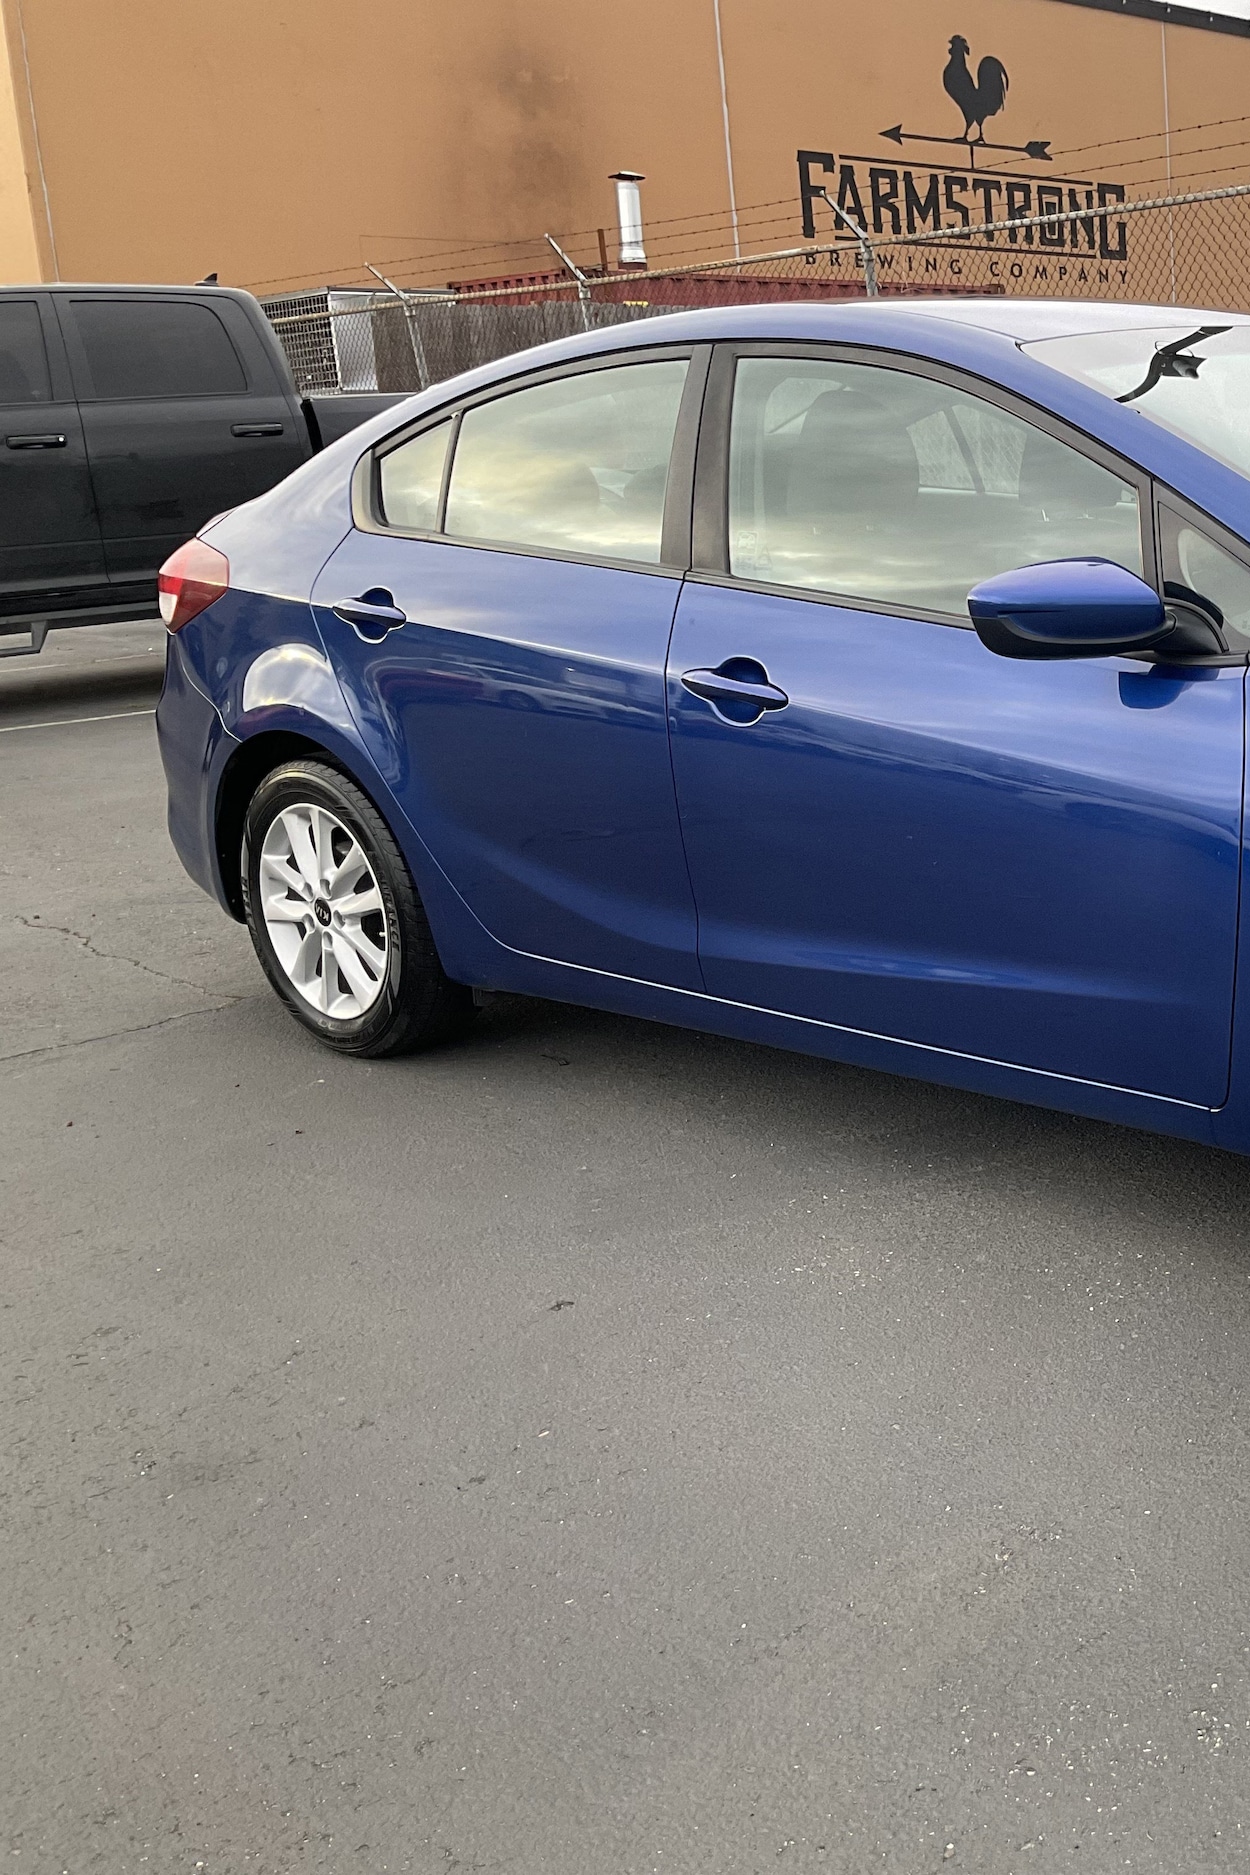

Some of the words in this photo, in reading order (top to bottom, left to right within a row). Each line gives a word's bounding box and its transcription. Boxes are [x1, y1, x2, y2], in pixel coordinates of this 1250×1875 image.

[797, 149, 1127, 261] FARMSTRONG
[804, 250, 963, 275] BREWING
[989, 260, 1128, 285] COMPANY
[315, 902, 330, 922] KIA
